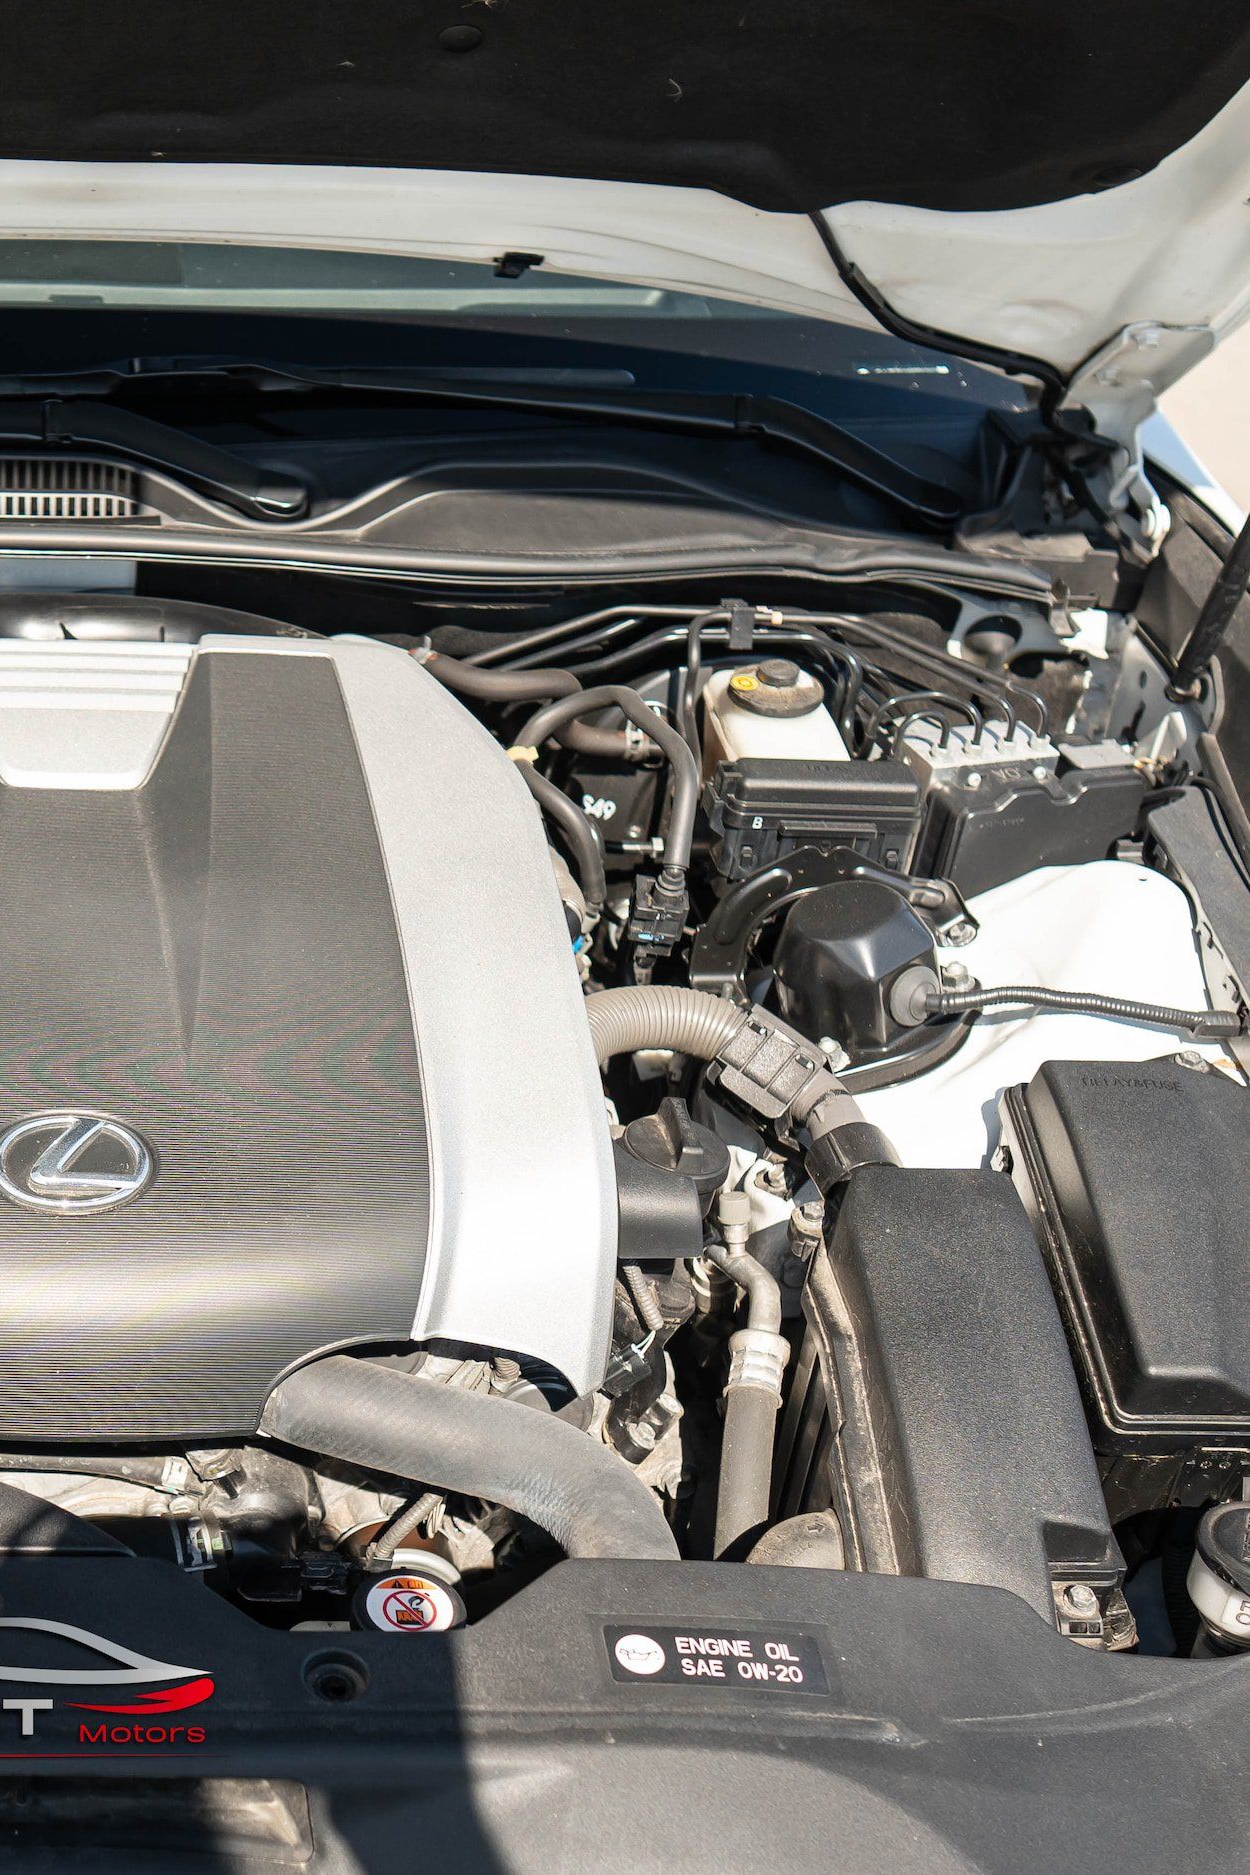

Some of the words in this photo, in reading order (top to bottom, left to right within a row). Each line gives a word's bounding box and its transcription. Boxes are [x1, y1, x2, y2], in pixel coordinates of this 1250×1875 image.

[752, 816, 764, 829] B
[674, 1636, 753, 1658] ENGINE
[764, 1642, 800, 1662] OIL
[681, 1658, 726, 1678] SAE
